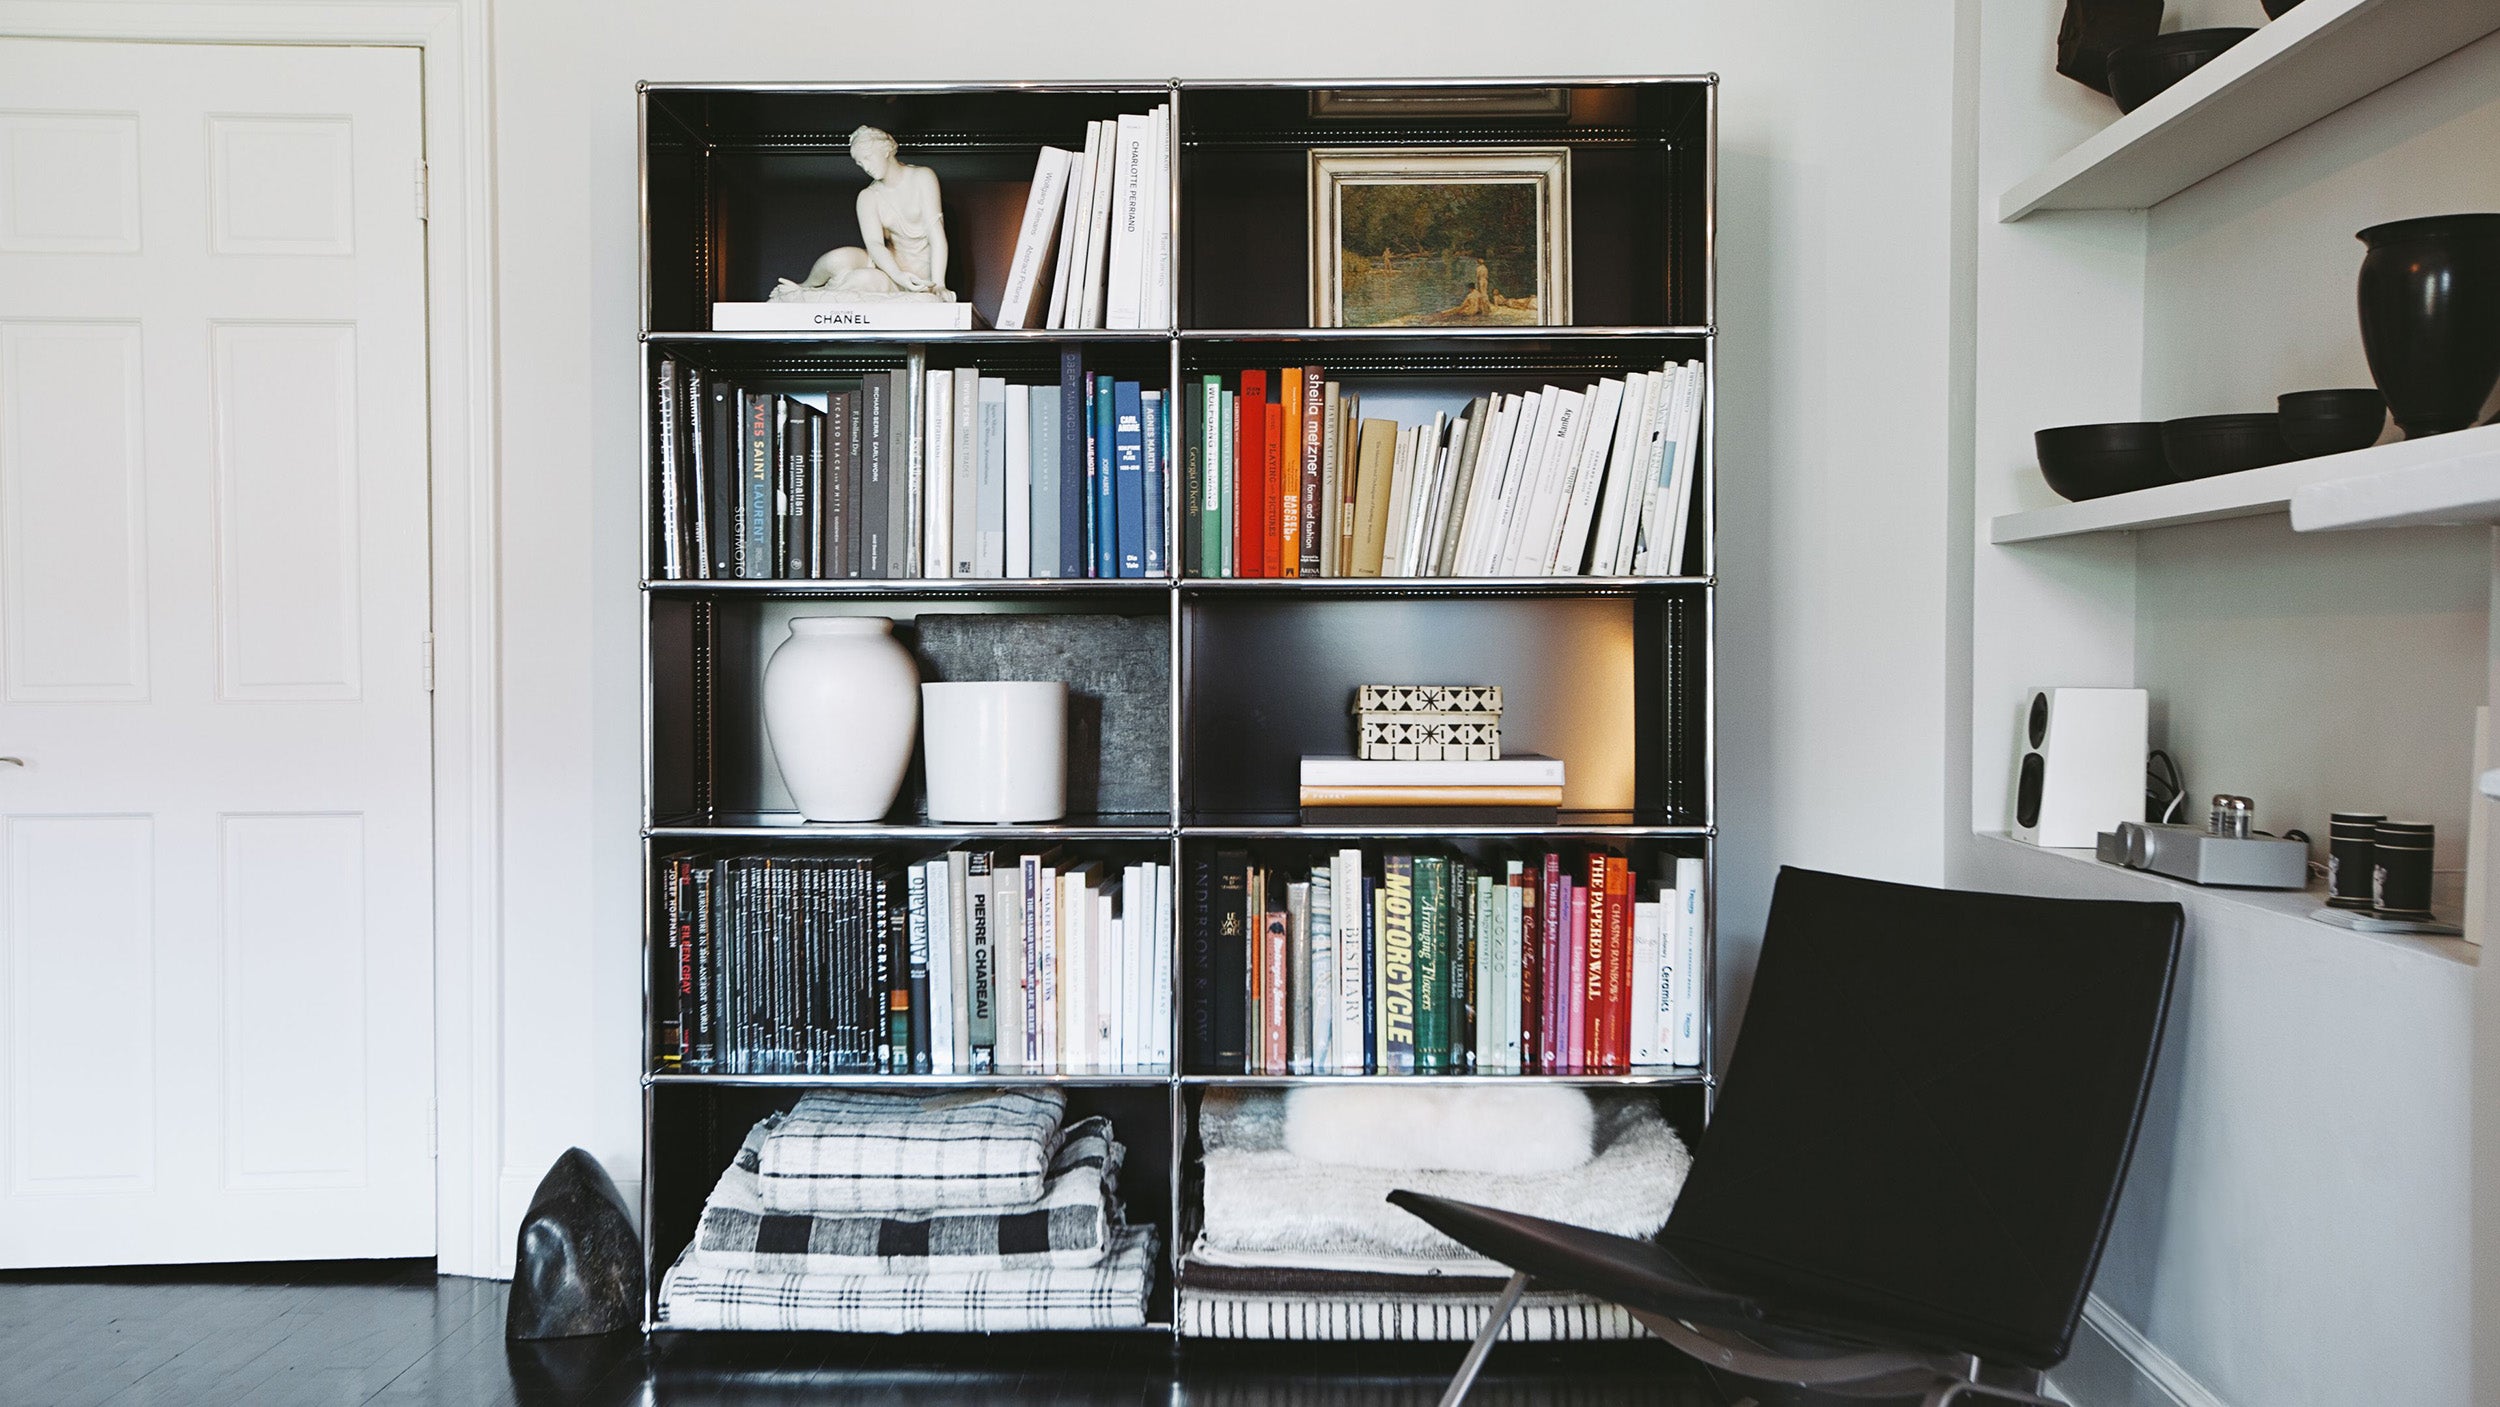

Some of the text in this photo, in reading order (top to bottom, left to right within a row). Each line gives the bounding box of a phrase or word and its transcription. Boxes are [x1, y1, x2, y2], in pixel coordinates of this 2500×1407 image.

[1030, 172, 1054, 236] Wolfgang Tillmans
[1127, 141, 1140, 233] CHARLOTTE PERRIAND
[1013, 245, 1035, 304] Abstract Pictures
[814, 314, 871, 324] CHANEL
[962, 380, 970, 407] IRVING
[1308, 374, 1324, 415] sheila
[753, 403, 765, 437] YVES
[834, 397, 842, 438] PICASSO
[852, 416, 860, 442] Holland
[870, 386, 879, 482] RICHARD SERRA EARLY WORK
[961, 428, 969, 450] SMALL
[1146, 407, 1157, 472] AGNES MARTIN
[1557, 407, 1574, 438] ManRay
[753, 440, 765, 481] SAINT
[851, 443, 859, 457] Day
[961, 451, 969, 478] TRADES
[1102, 458, 1110, 475] JOSEF
[1188, 446, 1199, 479] Georgia
[1306, 421, 1320, 477] metzner
[1326, 404, 1335, 486] HARRY CALLAHAN
[795, 454, 805, 516] minimalism
[1269, 443, 1278, 537] PLAYING PICTURES
[1306, 483, 1317, 503] form
[753, 483, 766, 544] LAURENT
[1283, 495, 1291, 541] DUCHAMP
[1290, 495, 1298, 533] MARCEL
[1305, 503, 1317, 519] and
[734, 506, 746, 578] SUGIMOTO
[1305, 520, 1316, 549] fashion
[1456, 864, 1464, 897] ENGLISH
[668, 868, 678, 948] JOSEF HOFFMANN
[698, 889, 708, 934] FURNITURE
[1026, 897, 1034, 912] THE
[1044, 888, 1052, 926] SHAKER
[698, 935, 708, 945] IN
[877, 883, 888, 983] EILEEN GRAY
[1026, 913, 1034, 942] SHAKER
[1511, 891, 1519, 979] CURTAINS
[1588, 856, 1605, 1001] THE PAPERED WALL
[681, 925, 691, 994] EILEEN GRAY
[974, 894, 988, 1019] PIERRE CHAREAU
[1159, 903, 1170, 1015] CHARLOTTE PERRIAND
[1194, 860, 1208, 1042] ANDERSON & LOW
[1386, 872, 1413, 1045] MOTORCYCLE
[1419, 896, 1436, 1012] Arranging Flowers
[1609, 903, 1621, 1003] CHASING RAINBOWS
[698, 964, 708, 1002] ANCIENT
[1045, 970, 1053, 1002] VIEWS
[1346, 927, 1360, 1025] BESTIARY
[1457, 963, 1465, 999] TEXTILES
[1571, 945, 1582, 1013] Living in Mexico
[1660, 965, 1674, 1013] Ceramics
[699, 1003, 709, 1033] WORLD
